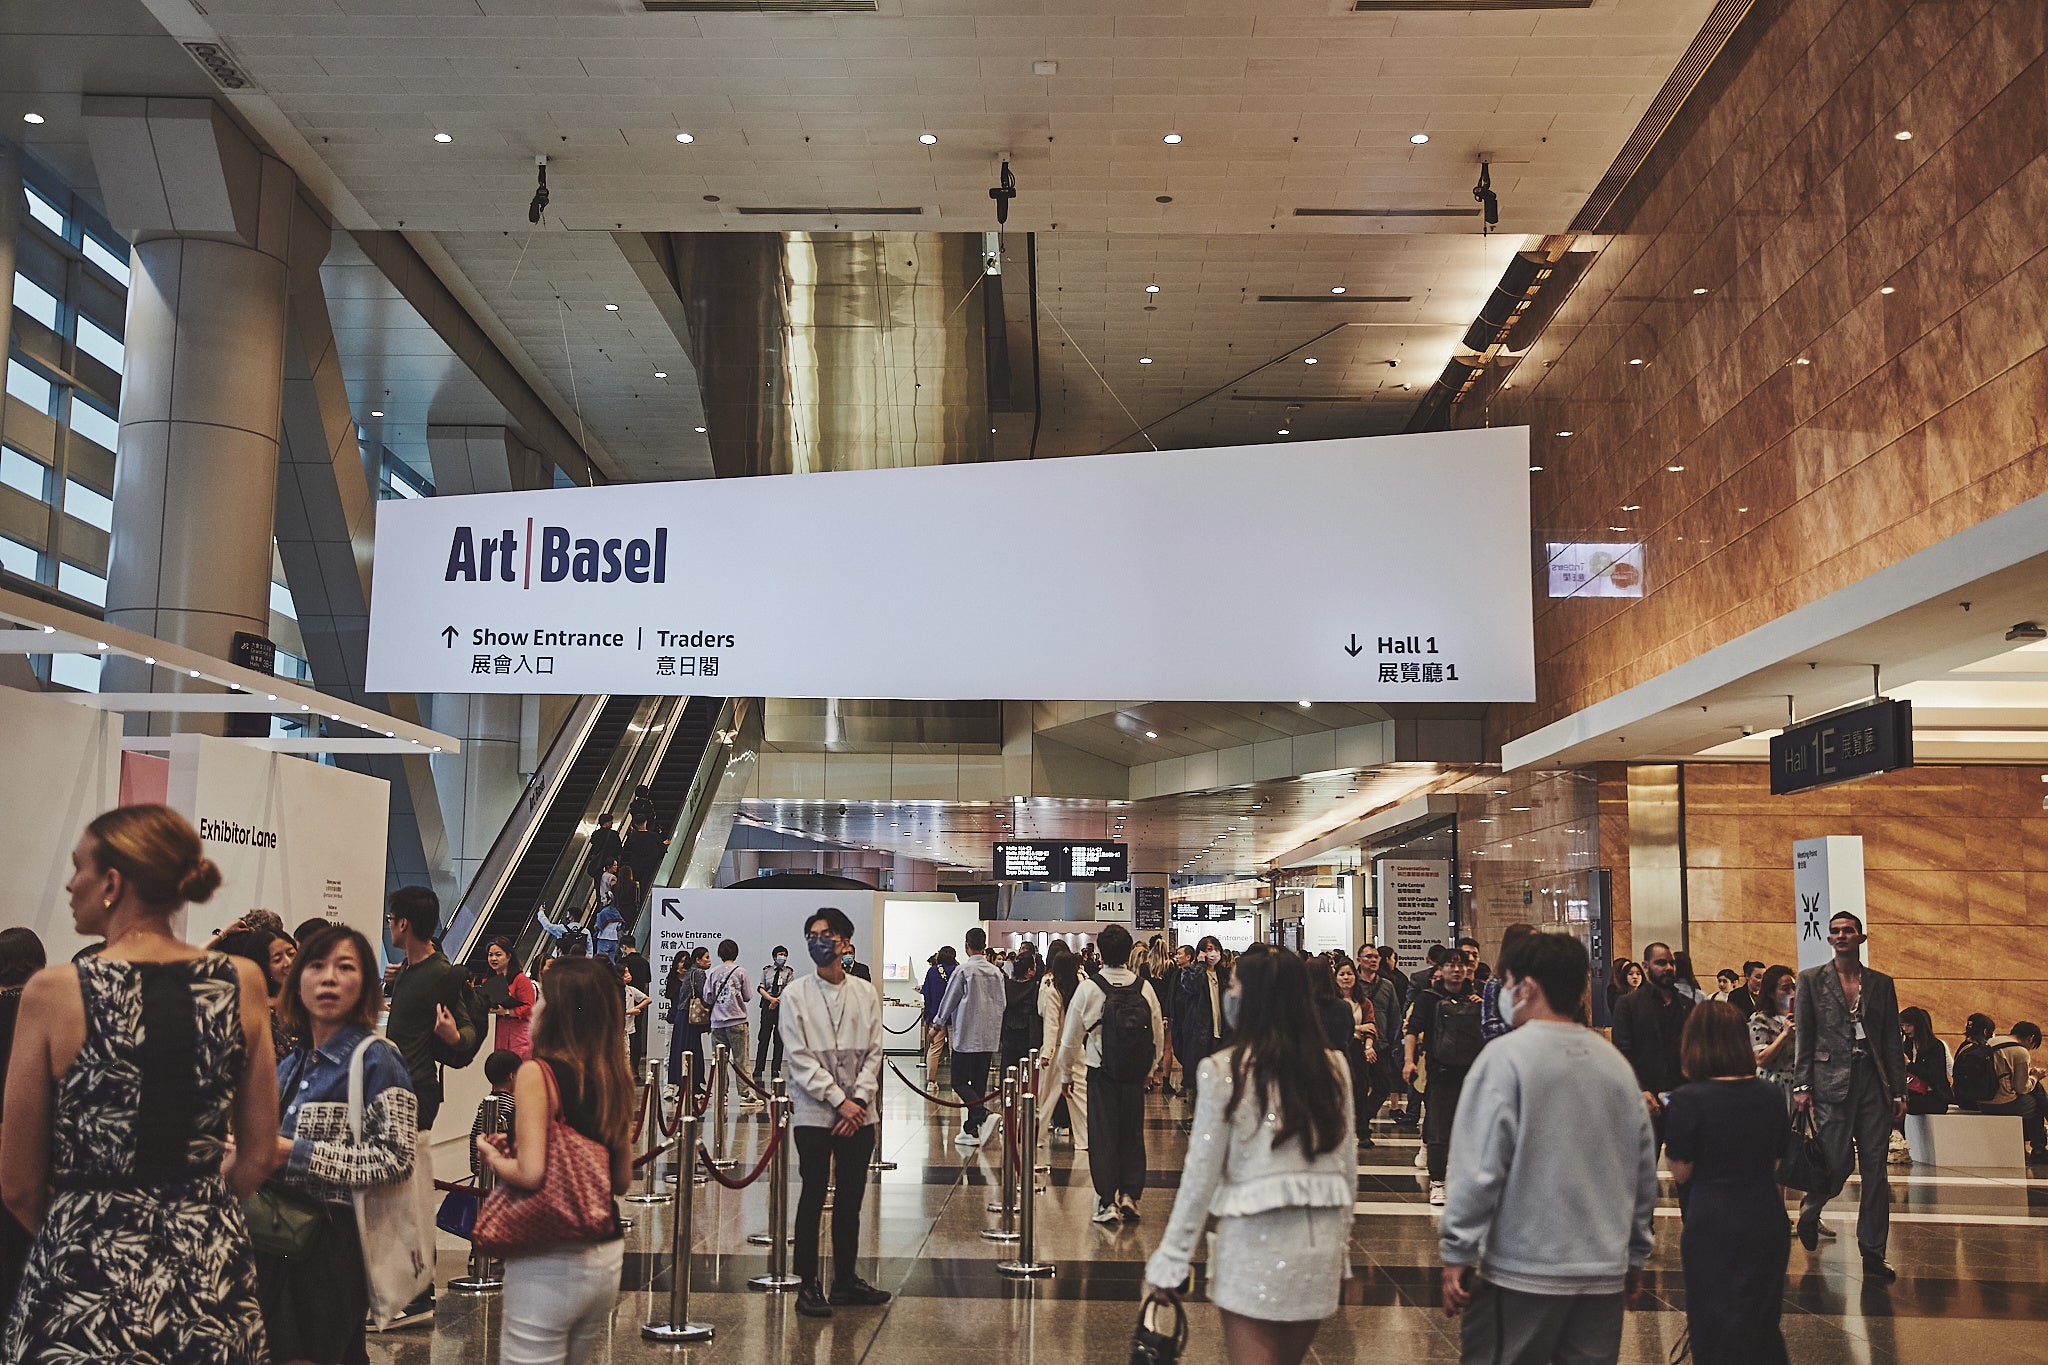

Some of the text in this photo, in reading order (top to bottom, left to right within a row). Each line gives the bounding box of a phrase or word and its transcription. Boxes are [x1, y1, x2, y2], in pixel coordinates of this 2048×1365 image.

[444, 526, 668, 584] Art Basel
[472, 628, 624, 647] Show Entrance
[656, 630, 735, 648] Traders
[1378, 636, 1439, 654] Hall 1
[471, 654, 554, 675] 展會入口
[656, 655, 719, 677] 意日閣
[1378, 662, 1459, 683] 展覽廳1
[1784, 744, 1807, 774] Hall
[1811, 727, 1836, 777] 1E
[200, 818, 277, 849] Exhibitor Lane
[1117, 902, 1125, 912] 1
[660, 930, 722, 939] Show Entrance
[660, 954, 674, 962] Tra
